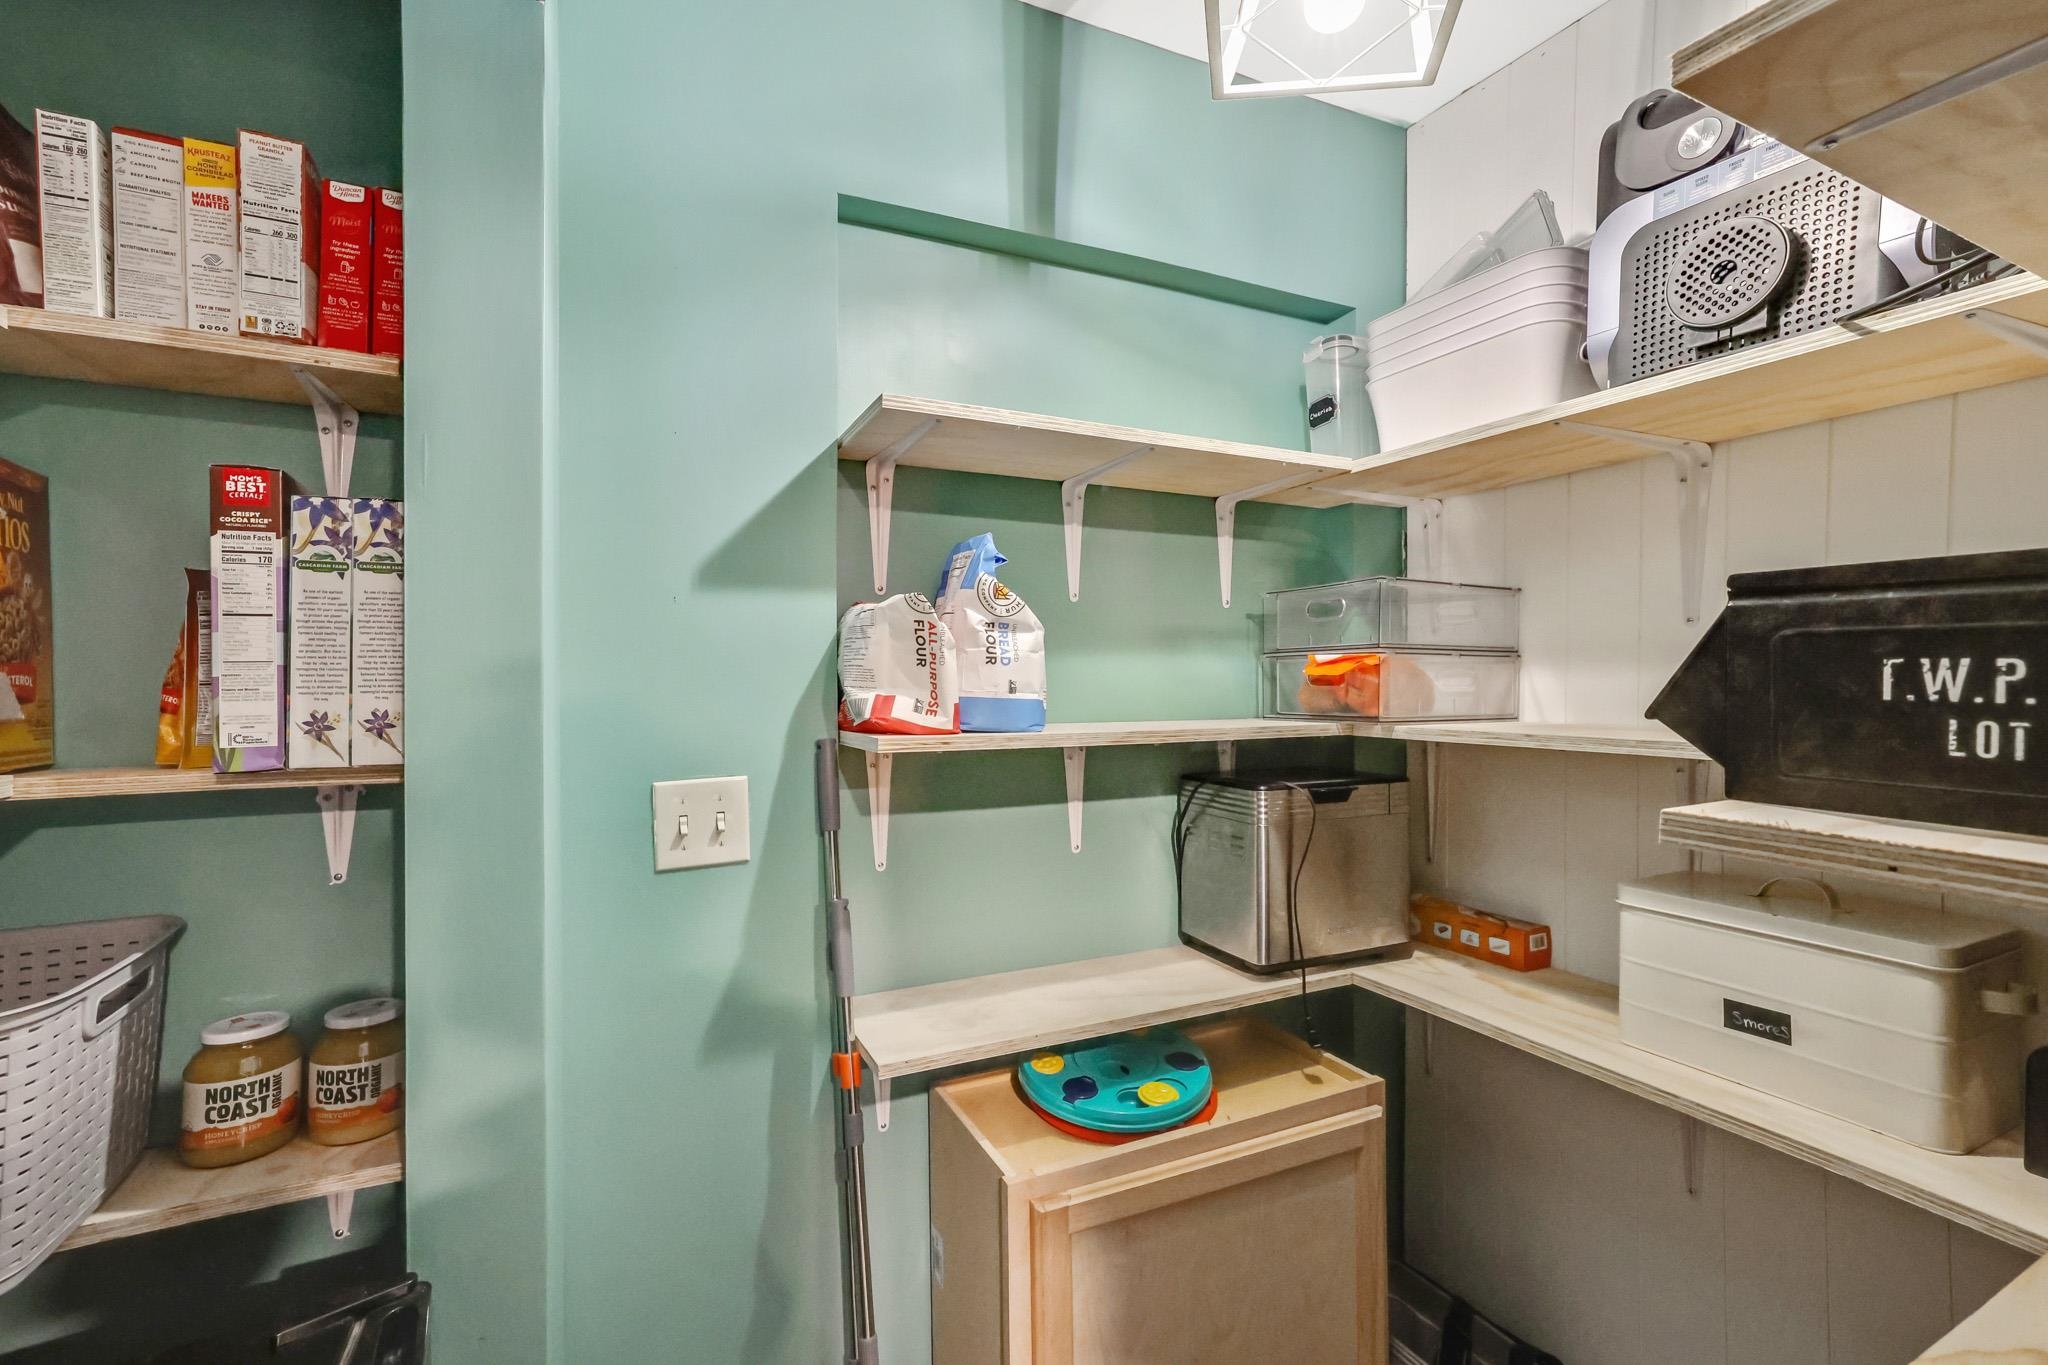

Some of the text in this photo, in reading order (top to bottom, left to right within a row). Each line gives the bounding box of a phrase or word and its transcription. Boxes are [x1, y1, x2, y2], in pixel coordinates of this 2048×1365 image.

[41, 113, 87, 127] Nutrition Facts
[249, 139, 293, 152] PEANUT BUTTER
[257, 146, 285, 156] GRANOLA
[130, 151, 179, 164] ANCIENT GRAINS
[187, 147, 231, 162] KRUSTEAZ
[130, 161, 157, 170] CARROTS
[187, 165, 234, 179] CORNBREAD
[197, 162, 223, 170] HONEY
[149, 188, 171, 196] ANALYSIS
[332, 184, 362, 193] Duncan
[192, 191, 229, 203] MAKERS
[192, 199, 229, 211] WANTED
[243, 199, 299, 215] Nutrition Facts
[329, 215, 361, 227] Moist
[120, 243, 176, 257] NUTRITIONAL STATEMENT
[230, 475, 262, 483] MOM'S
[225, 481, 266, 493] BEST
[229, 492, 264, 500] CEREALS
[258, 556, 273, 564] 170
[1005, 601, 1022, 614] HUR
[913, 620, 927, 668] FLOUR
[985, 622, 997, 665] FLOUR
[998, 623, 1011, 666] BREAD
[925, 620, 939, 718] ALL-PURPOSE
[1948, 718, 2032, 761] LOT
[316, 1066, 369, 1087] NORTH
[370, 1063, 382, 1099] ORGANIC
[205, 1076, 271, 1105] NORTH
[271, 1071, 283, 1110] ORGANIC
[316, 1083, 369, 1105] COAST
[204, 1094, 270, 1125] COAST
[204, 1122, 262, 1139] HONEYCRISP
